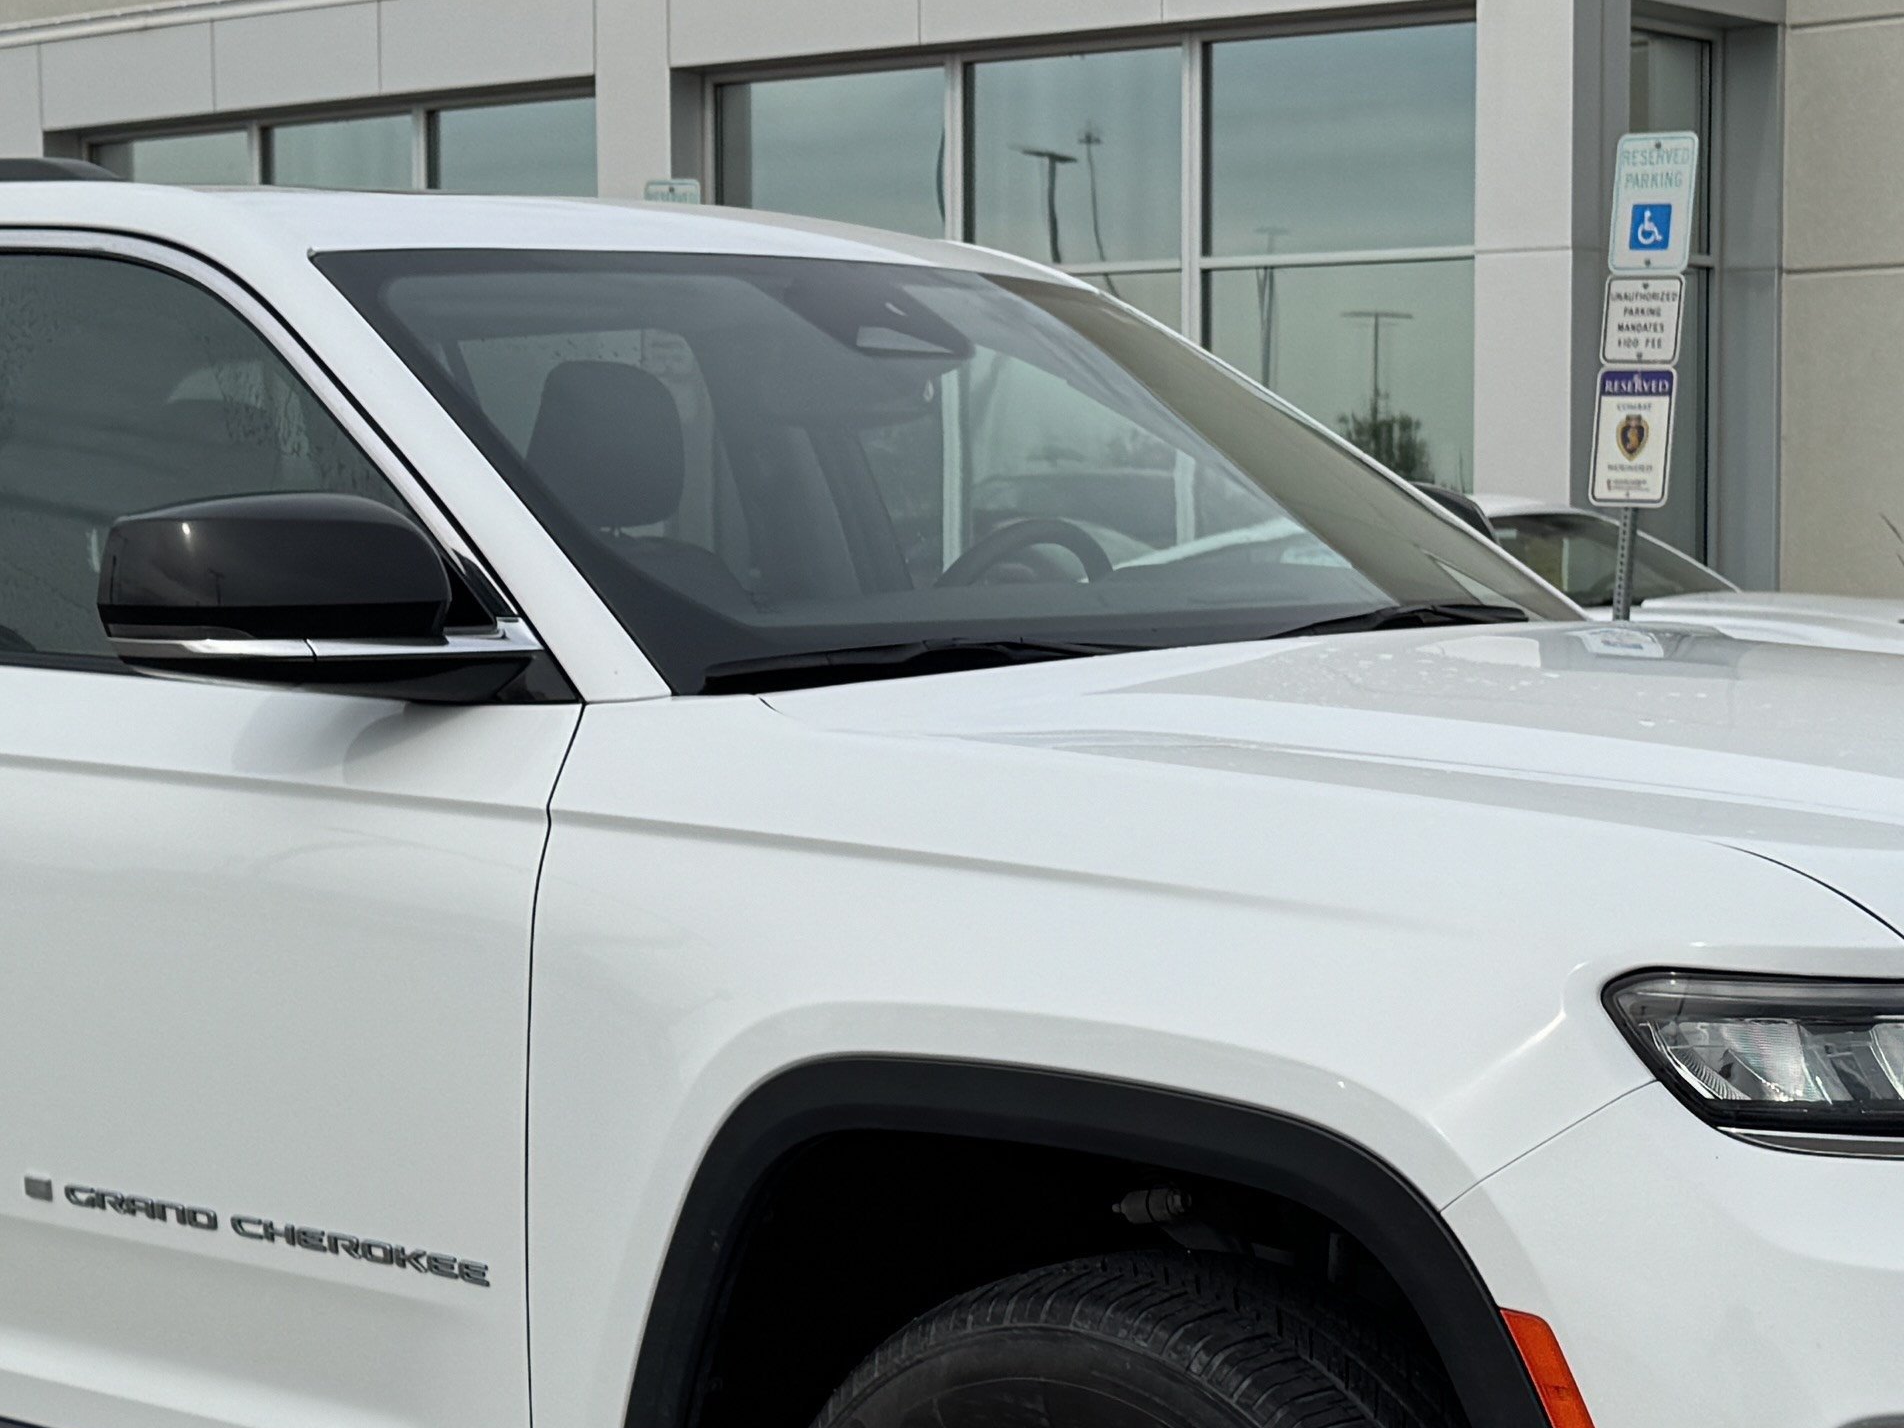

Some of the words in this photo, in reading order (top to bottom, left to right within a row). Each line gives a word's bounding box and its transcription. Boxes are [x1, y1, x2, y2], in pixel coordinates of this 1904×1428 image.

[1622, 148, 1690, 166] RESERVED
[1624, 172, 1683, 189] PARKING
[1610, 292, 1678, 302] UNAUTHORIZED
[1623, 306, 1662, 317] PARKING
[1617, 322, 1664, 333] MANDATES
[1604, 379, 1670, 393] RESERVED
[63, 1183, 218, 1231] GRAND
[229, 1213, 491, 1288] CHEROKEE
